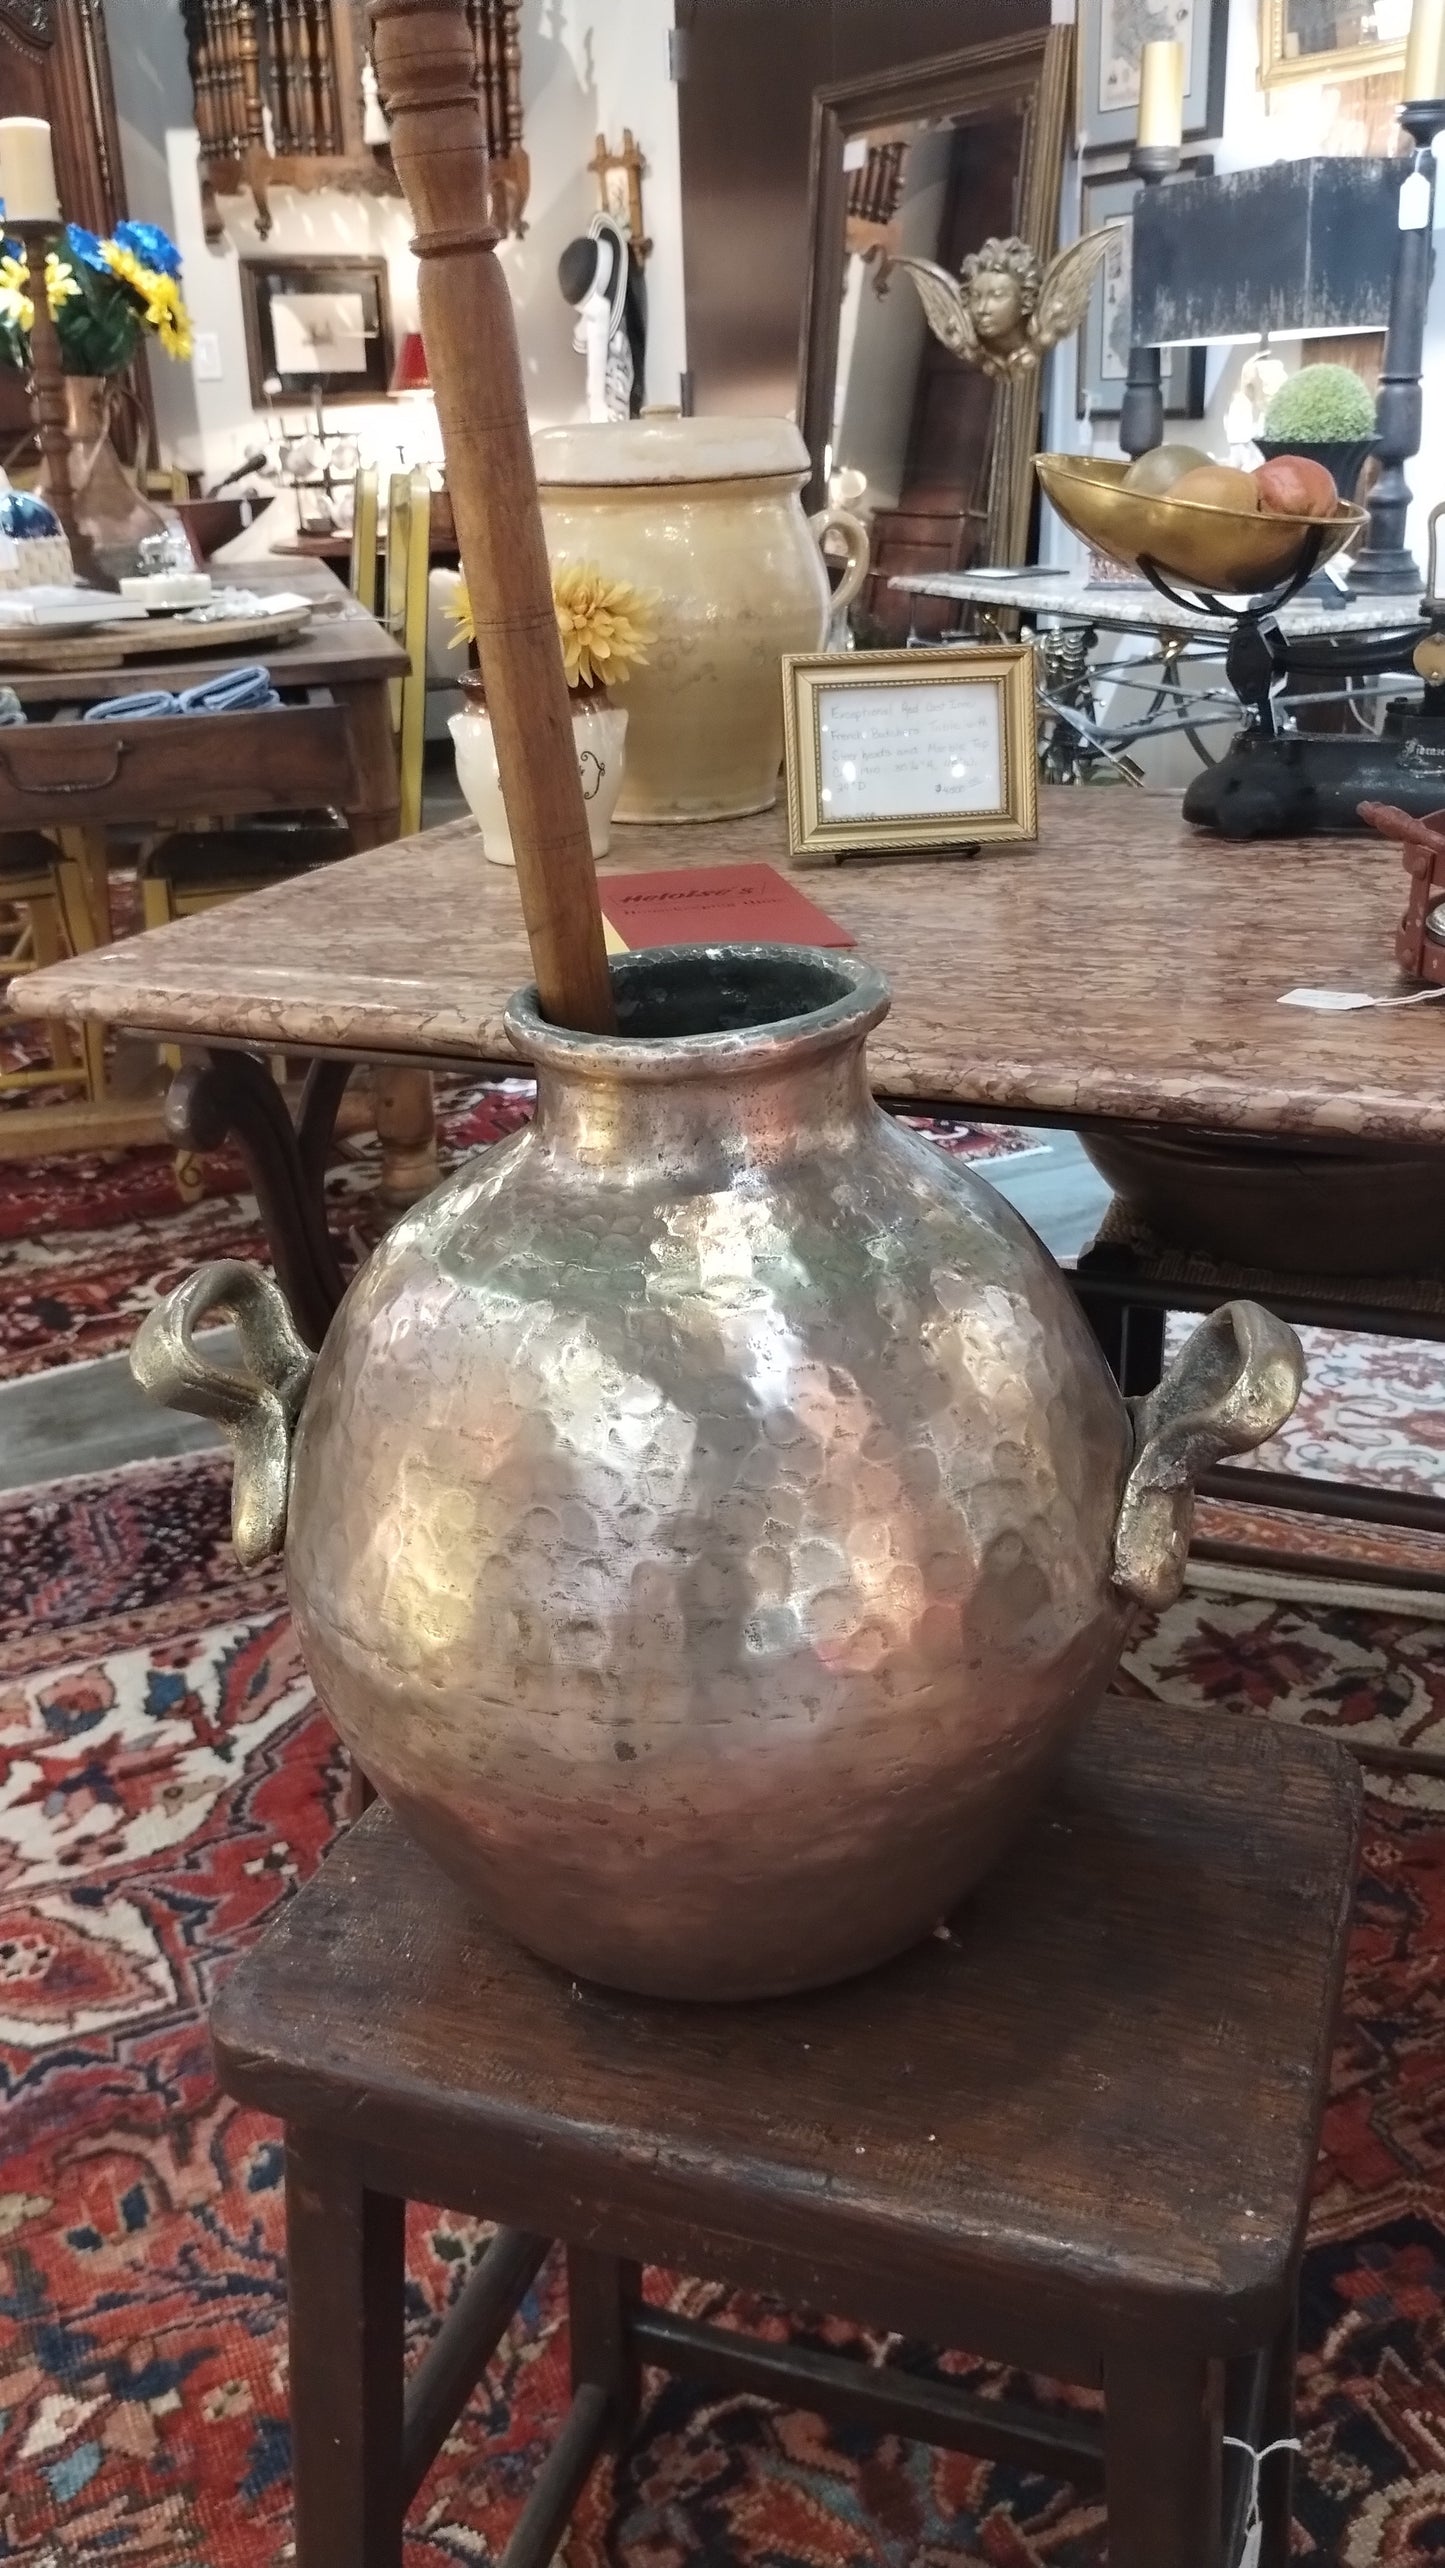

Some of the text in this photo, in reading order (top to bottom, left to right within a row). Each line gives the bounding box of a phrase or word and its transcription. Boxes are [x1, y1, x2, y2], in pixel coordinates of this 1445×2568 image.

[831, 704, 893, 722] Exceptional
[831, 728, 863, 741] French
[621, 885, 755, 904] Heloise's
